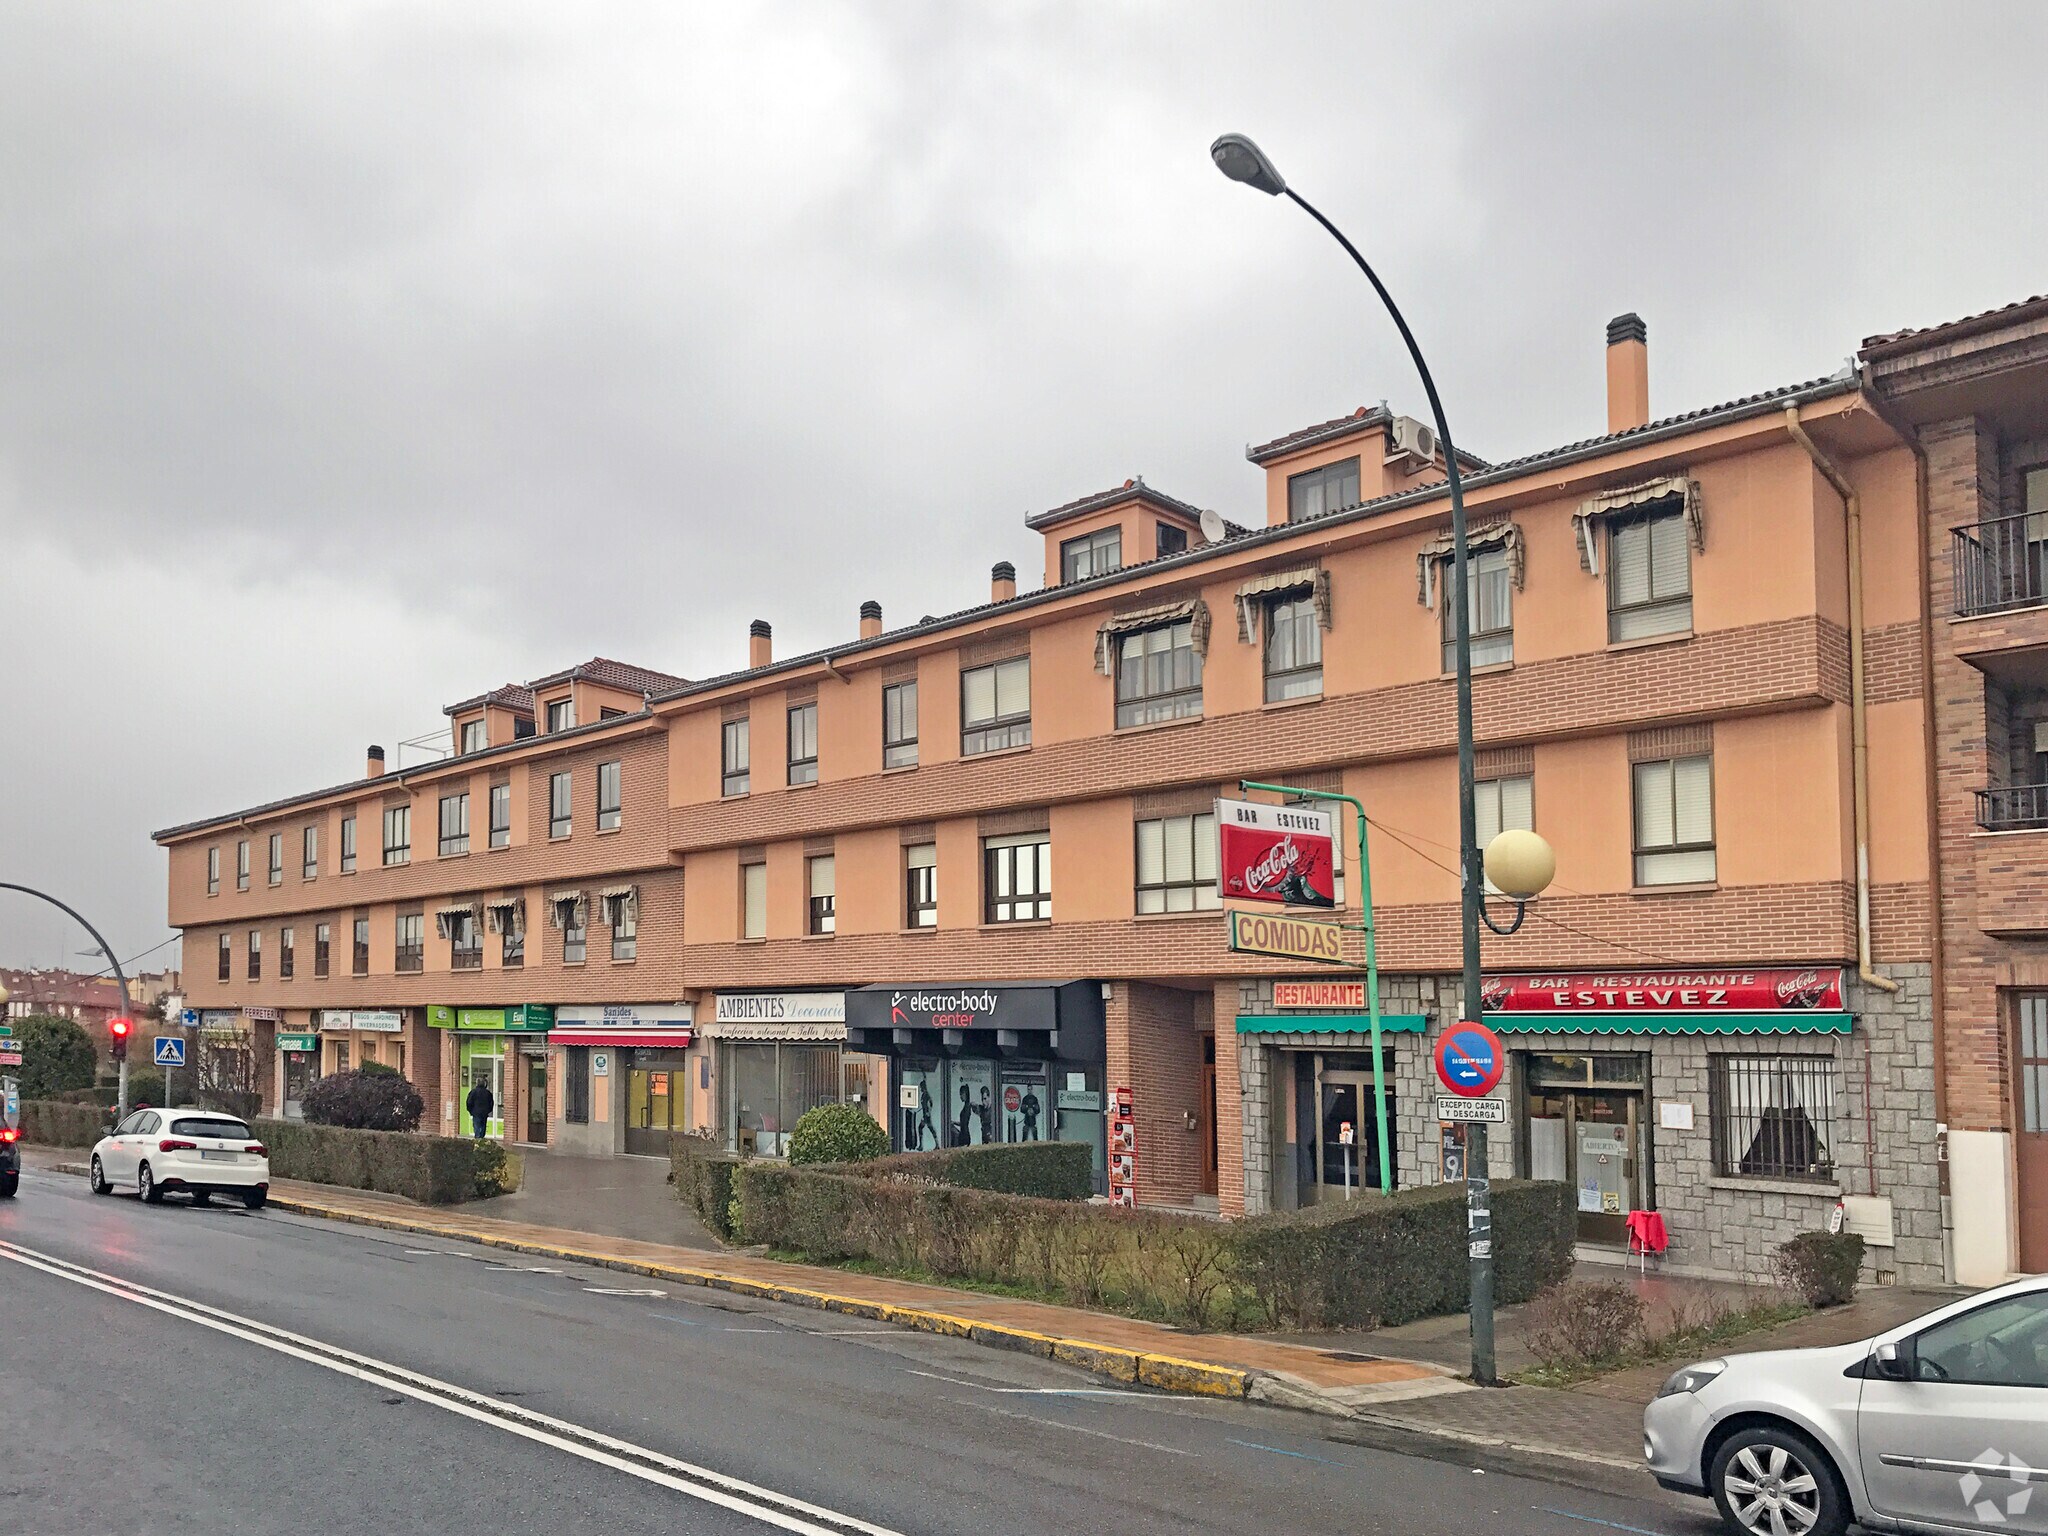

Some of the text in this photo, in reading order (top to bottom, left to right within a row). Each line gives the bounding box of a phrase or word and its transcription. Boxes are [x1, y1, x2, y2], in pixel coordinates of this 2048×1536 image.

[1236, 807, 1321, 831] BAR ESTEVEZ
[1239, 917, 1339, 957] COMIDAS
[1528, 978, 1570, 989] BAR
[1592, 974, 1755, 987] RESTAURANTE
[910, 990, 998, 1015] electro-body
[1275, 985, 1363, 1005] RESTAURANTE
[1552, 990, 1729, 1006] ESTEVEZ
[719, 997, 785, 1018] AMBIENTES
[931, 1011, 975, 1027] center
[1067, 1093, 1099, 1104] electro-body
[1440, 1100, 1500, 1111] EXCEPTO CARGA
[1446, 1109, 1496, 1119] Y DESCARGA
